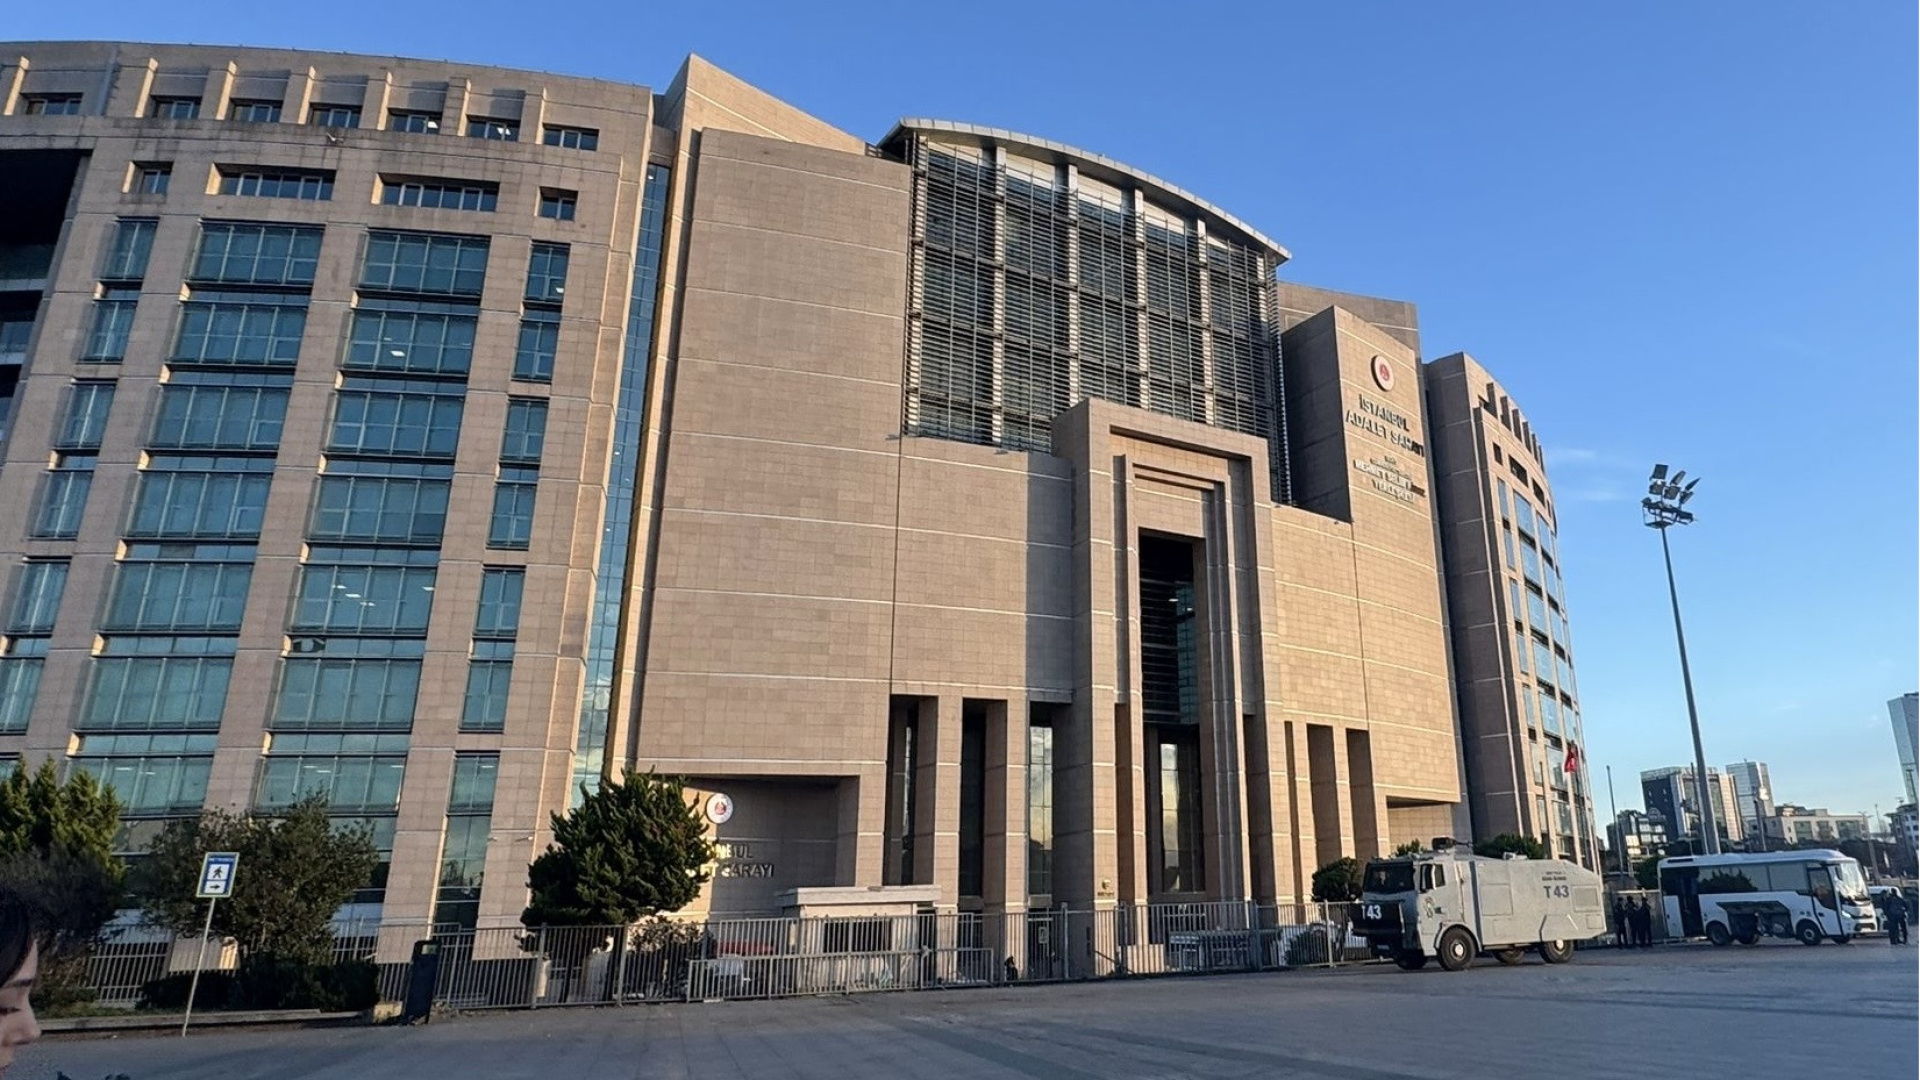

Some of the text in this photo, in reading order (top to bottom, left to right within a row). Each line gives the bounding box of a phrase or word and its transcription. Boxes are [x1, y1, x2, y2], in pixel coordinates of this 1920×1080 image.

[1346, 410, 1387, 439] ADALET
[721, 863, 775, 878] SARAYI
[1543, 885, 1569, 898] T 43
[1367, 904, 1382, 919] 43
